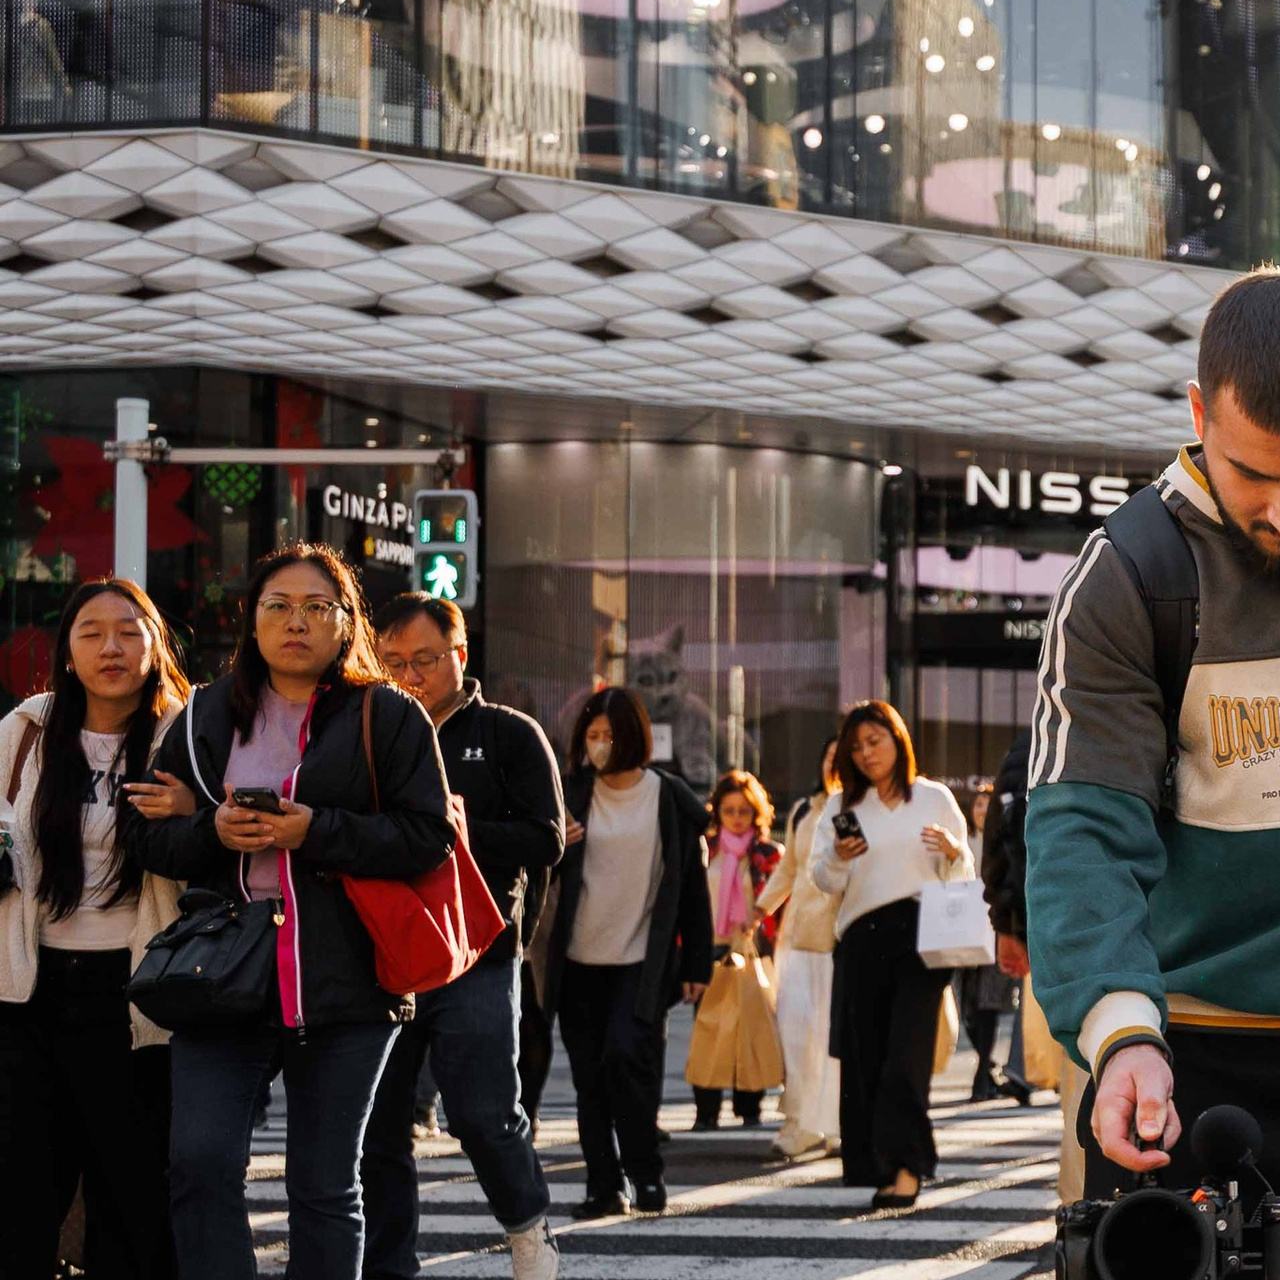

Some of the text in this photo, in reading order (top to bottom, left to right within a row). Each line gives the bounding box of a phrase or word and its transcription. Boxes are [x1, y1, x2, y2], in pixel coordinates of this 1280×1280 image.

[323, 484, 390, 528] GINZA
[1242, 750, 1276, 769] CRAZY
[1262, 791, 1278, 799] PRO
